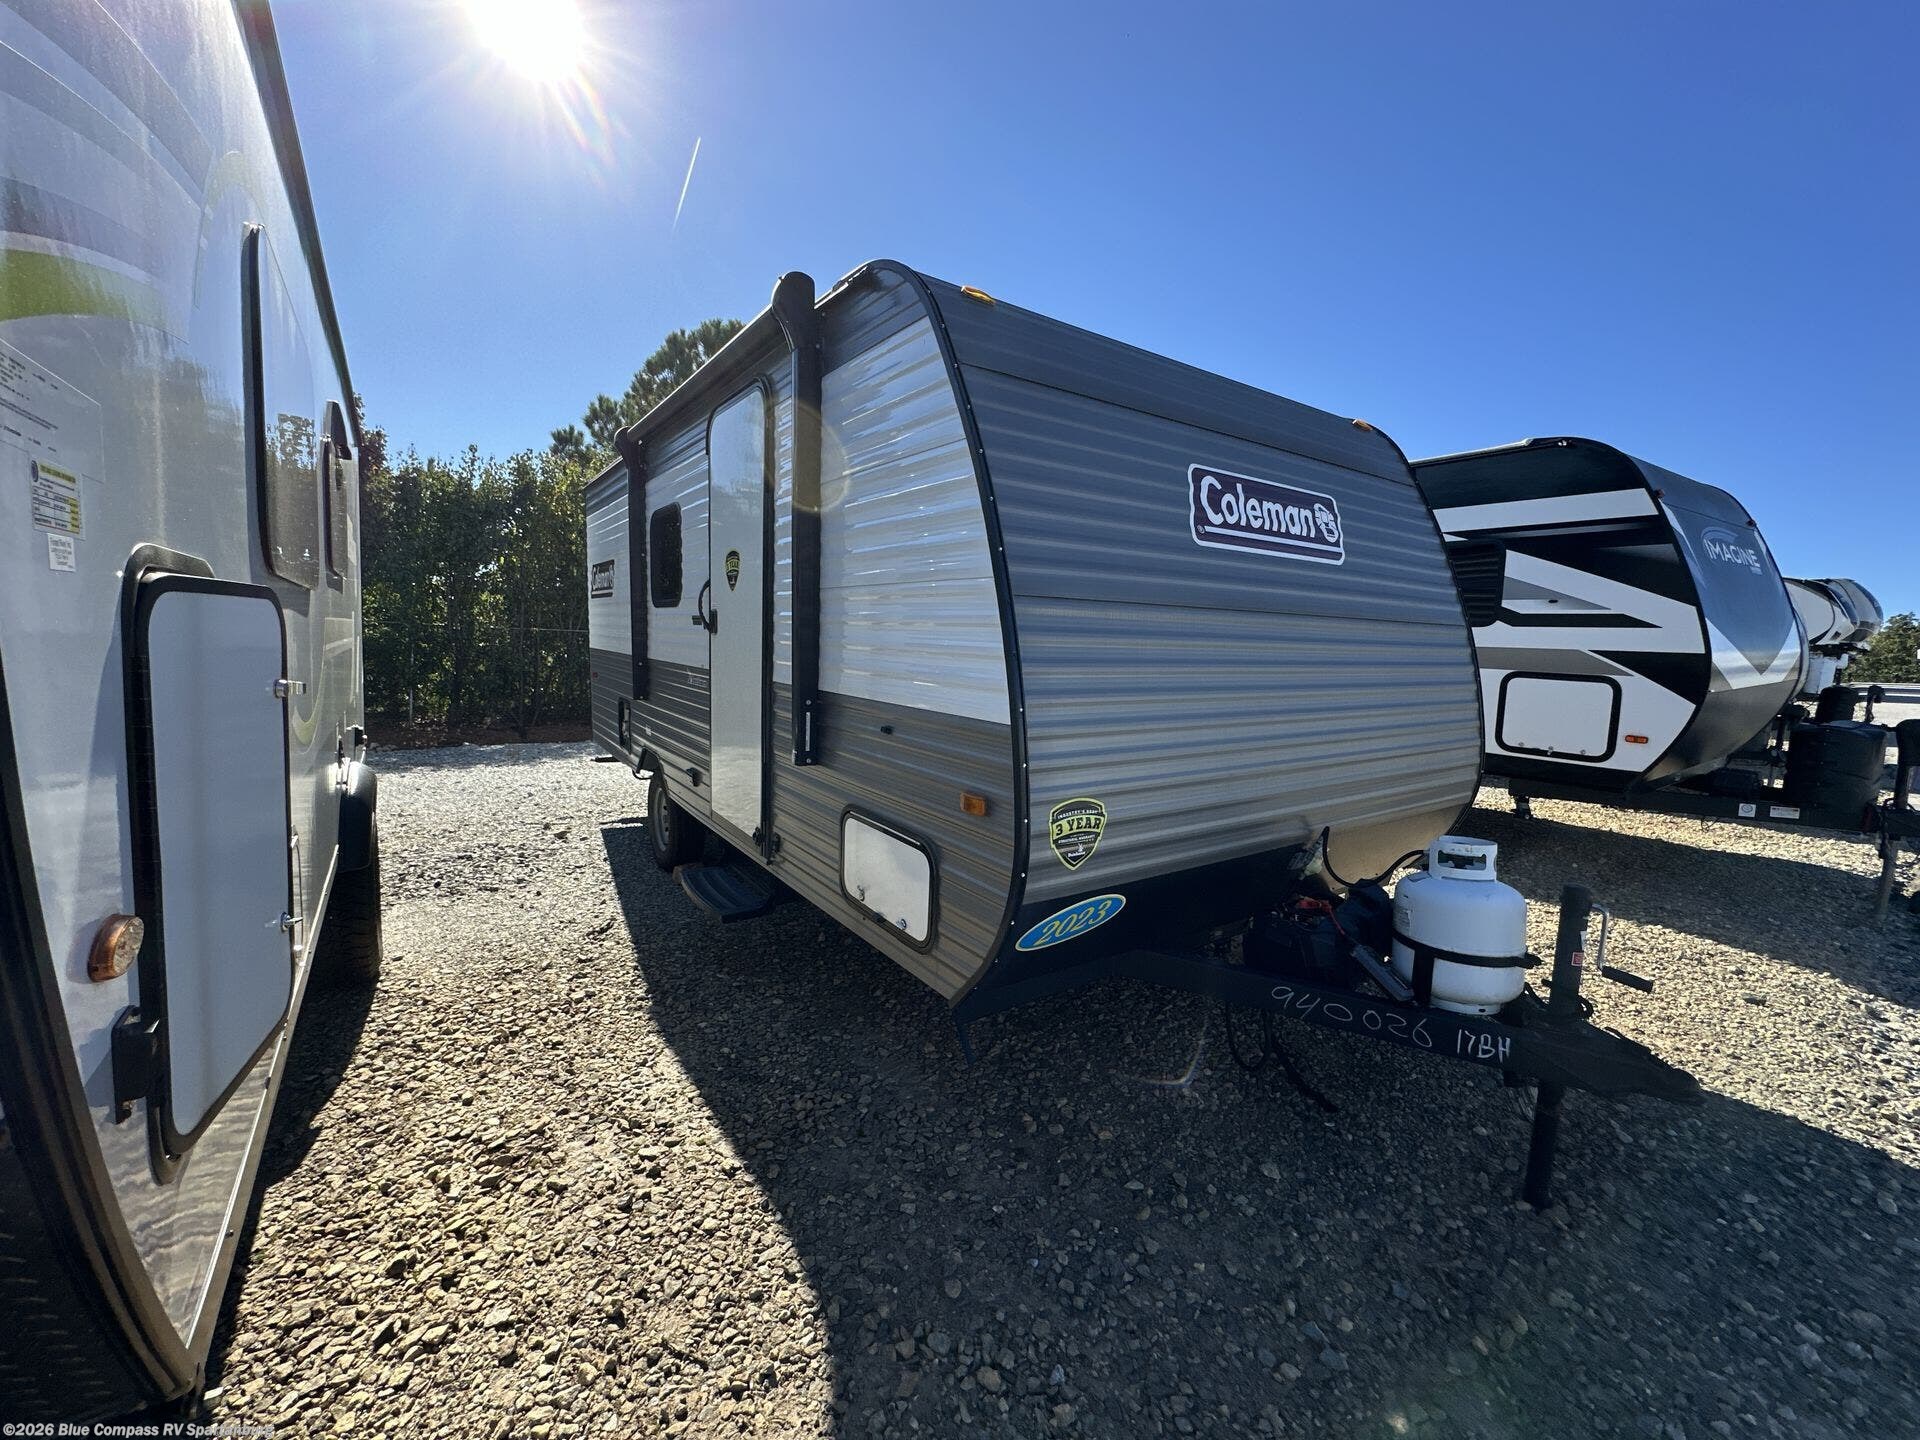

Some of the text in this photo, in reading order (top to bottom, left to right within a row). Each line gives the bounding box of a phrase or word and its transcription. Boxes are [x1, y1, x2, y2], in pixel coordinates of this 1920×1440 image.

[1200, 475, 1316, 538] Coleman
[1056, 823, 1063, 837] 3
[1067, 817, 1102, 831] YEAR
[1033, 899, 1112, 946] 2023
[1456, 1028, 1511, 1064] 17BH
